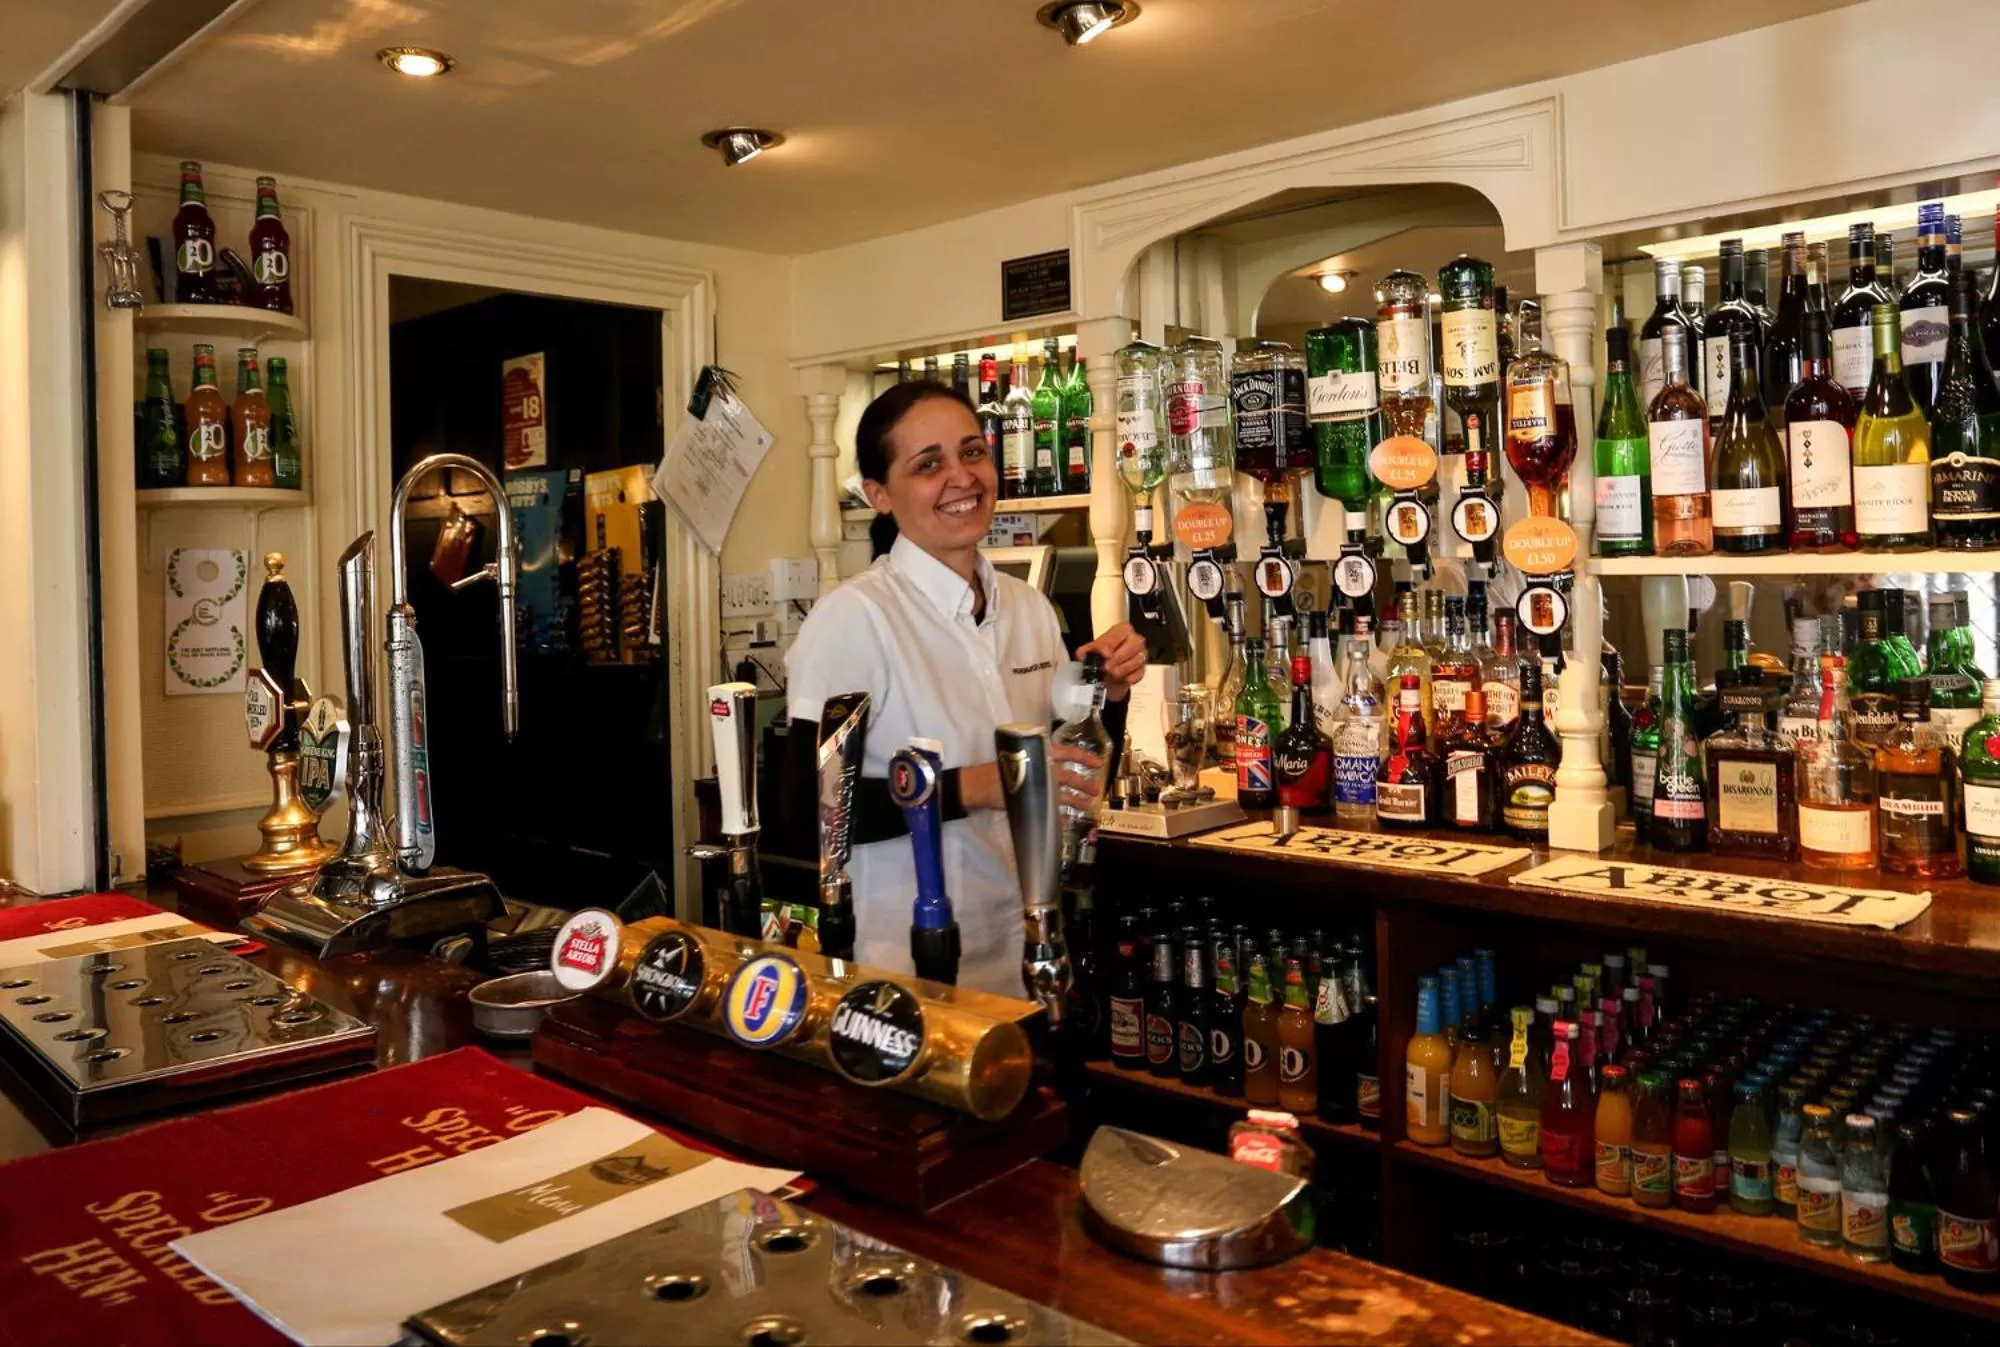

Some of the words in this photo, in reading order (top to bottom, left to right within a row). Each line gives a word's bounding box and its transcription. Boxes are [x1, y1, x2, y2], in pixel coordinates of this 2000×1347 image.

[1312, 383, 1369, 403] Gordon's
[522, 395, 540, 420] 18
[1178, 519, 1213, 530] DOUBLE
[1215, 518, 1228, 527] UP
[1510, 538, 1555, 550] DOUBLE
[1527, 551, 1556, 566] £1.50
[301, 757, 331, 790] IPA
[1659, 770, 1695, 785] bottle
[1666, 782, 1700, 798] green
[1722, 785, 1773, 796] DISARONNO
[1541, 866, 1898, 916] ABBOT
[571, 938, 600, 953] STELLA
[567, 951, 598, 966] ARTOIS
[744, 975, 778, 1020] F
[831, 1002, 918, 1057] GUINNESS
[515, 1183, 585, 1216] Menu
